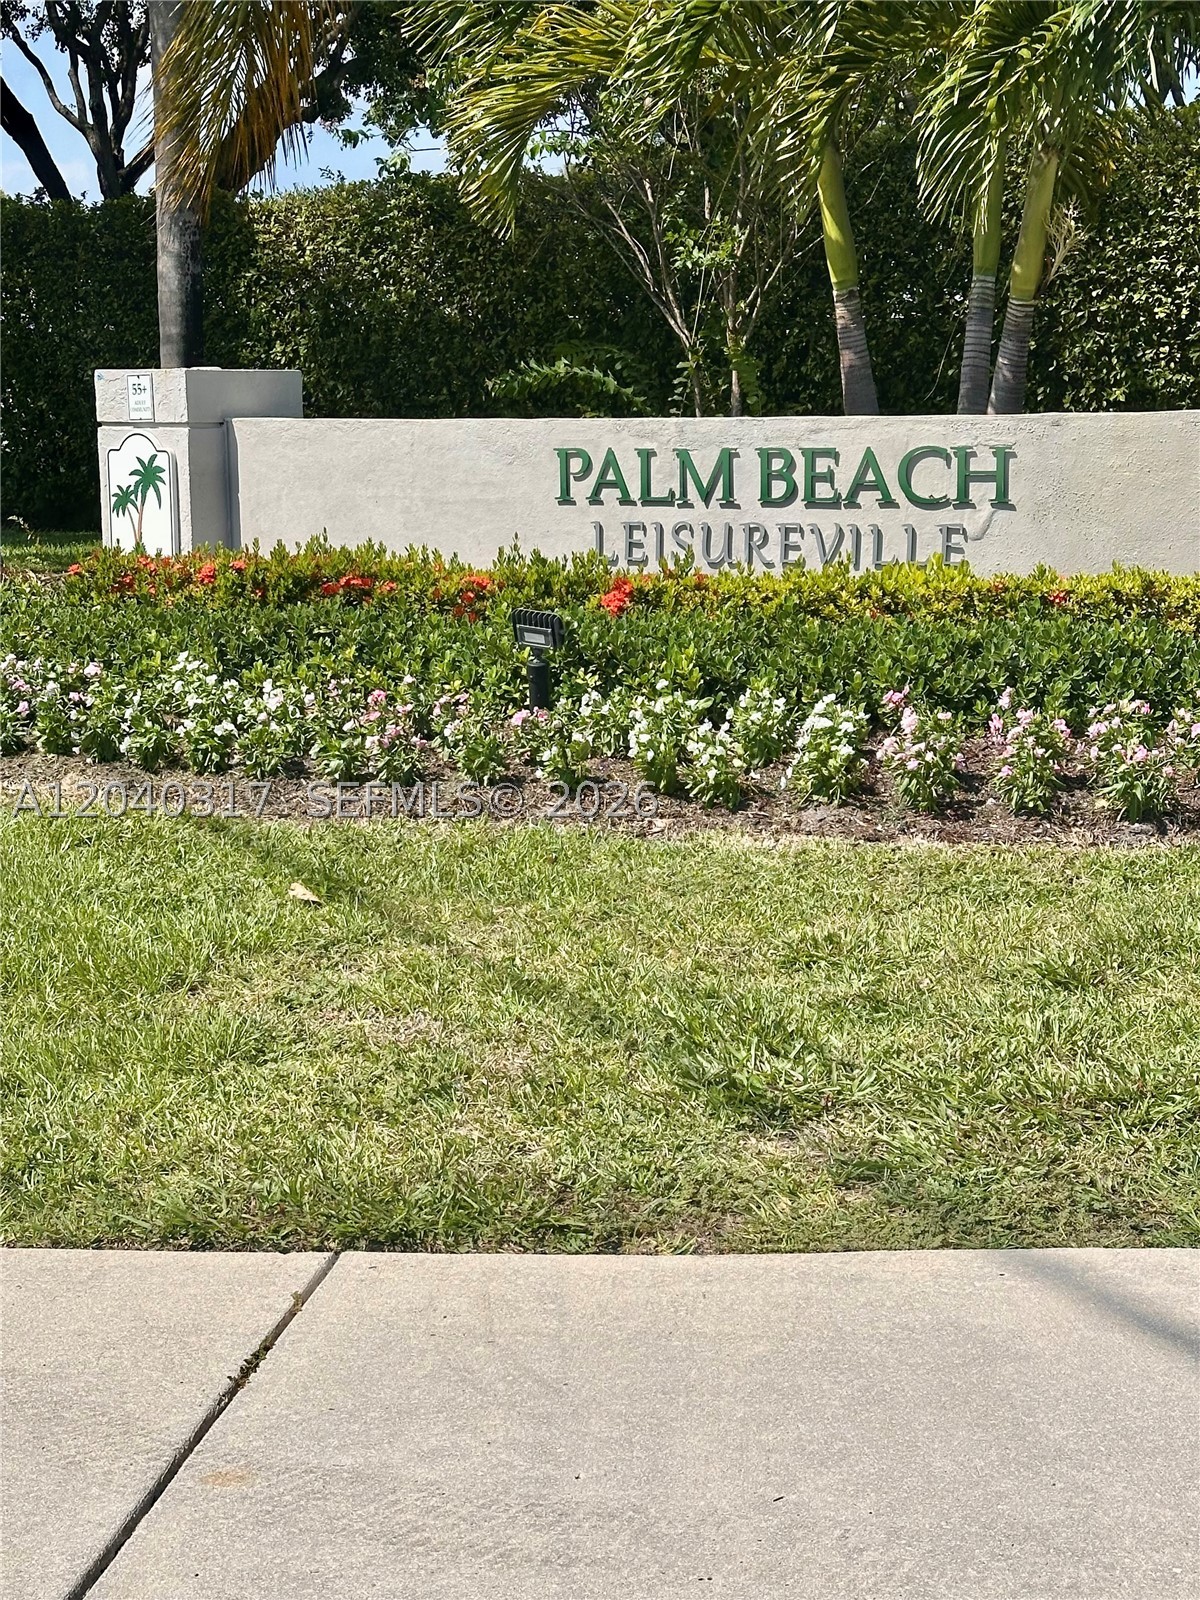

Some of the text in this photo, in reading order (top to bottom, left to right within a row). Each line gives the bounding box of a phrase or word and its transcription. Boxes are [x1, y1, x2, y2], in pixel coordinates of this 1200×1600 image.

[131, 383, 147, 396] 55+
[553, 445, 1014, 508] PALM BEACH
[591, 521, 969, 570] LEISUREVILLE
